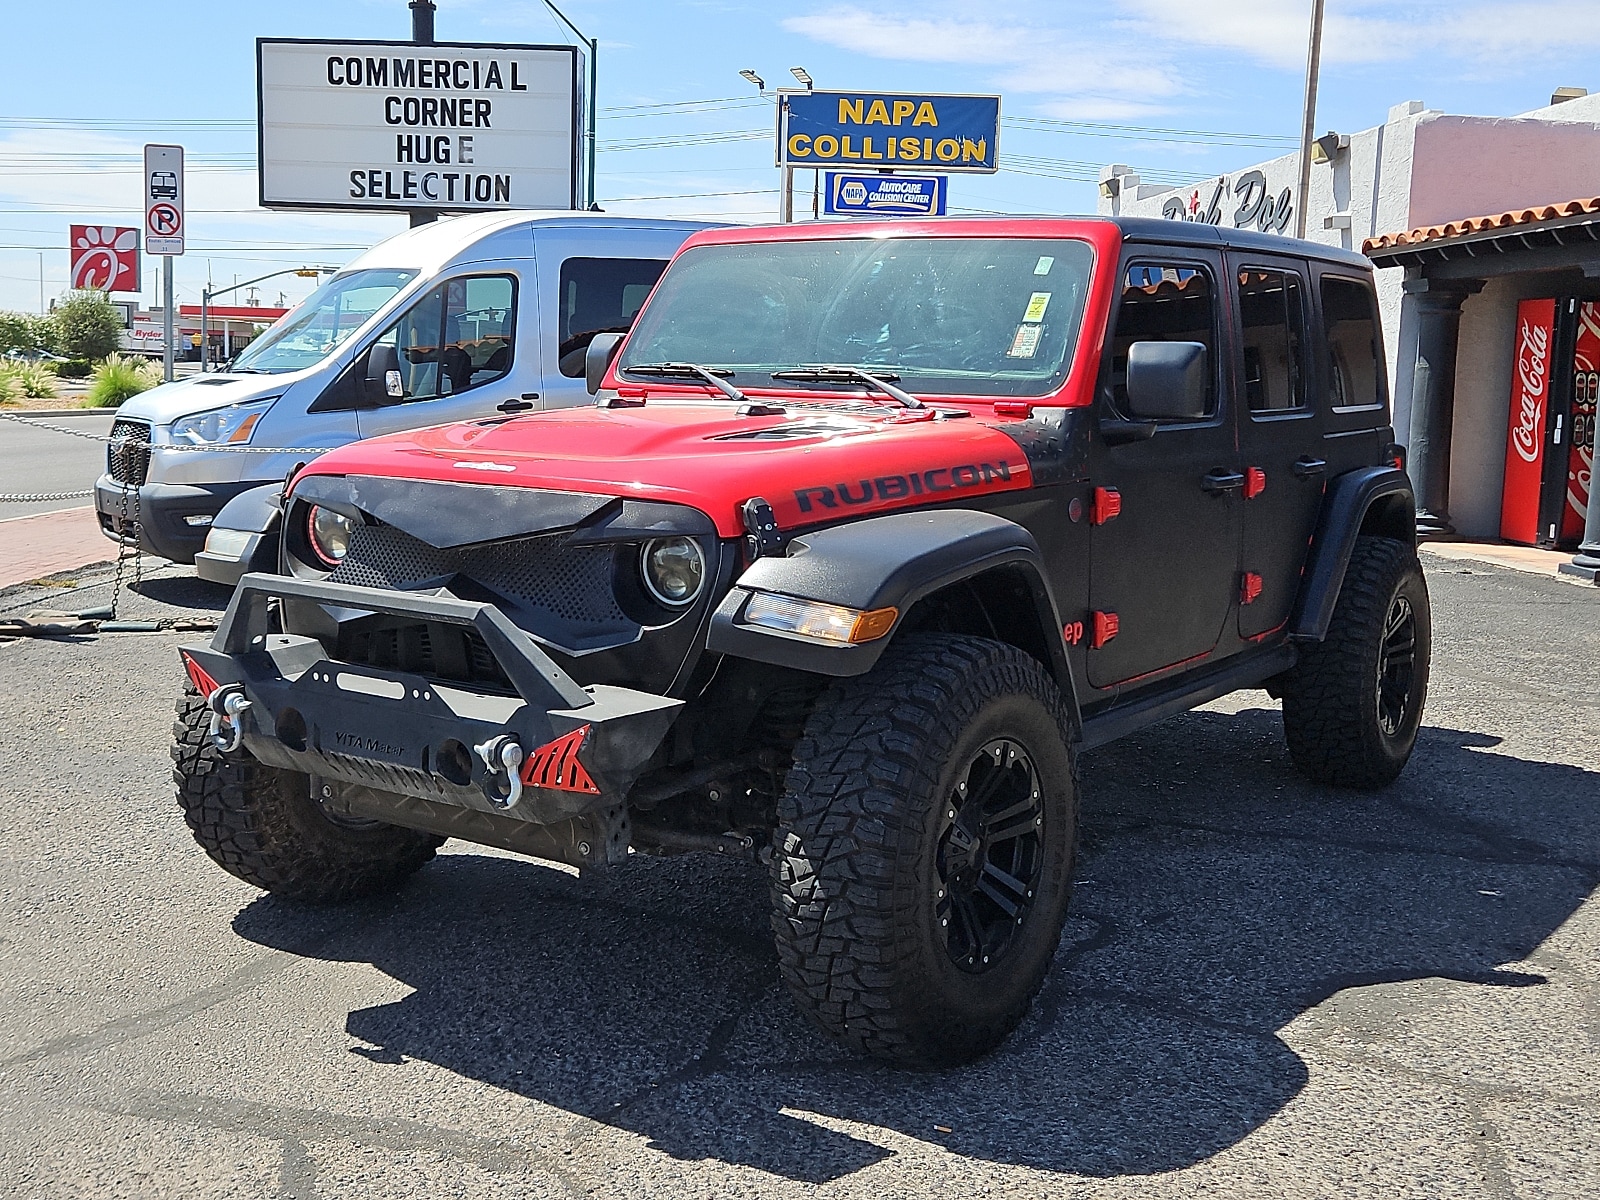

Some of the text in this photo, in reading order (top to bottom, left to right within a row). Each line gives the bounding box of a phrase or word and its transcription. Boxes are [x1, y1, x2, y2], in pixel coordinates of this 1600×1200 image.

[327, 56, 527, 90] COMMERCIAL
[385, 96, 492, 128] CORNER
[838, 98, 939, 127] NAPA
[397, 134, 474, 164] HUGE
[788, 134, 987, 162] COLLISION
[350, 170, 511, 203] SELECTION
[845, 187, 864, 199] NAPA
[134, 329, 163, 339] Ryder
[794, 461, 1012, 513] RUBICON
[1064, 621, 1083, 645] ep
[335, 731, 363, 749] YITA
